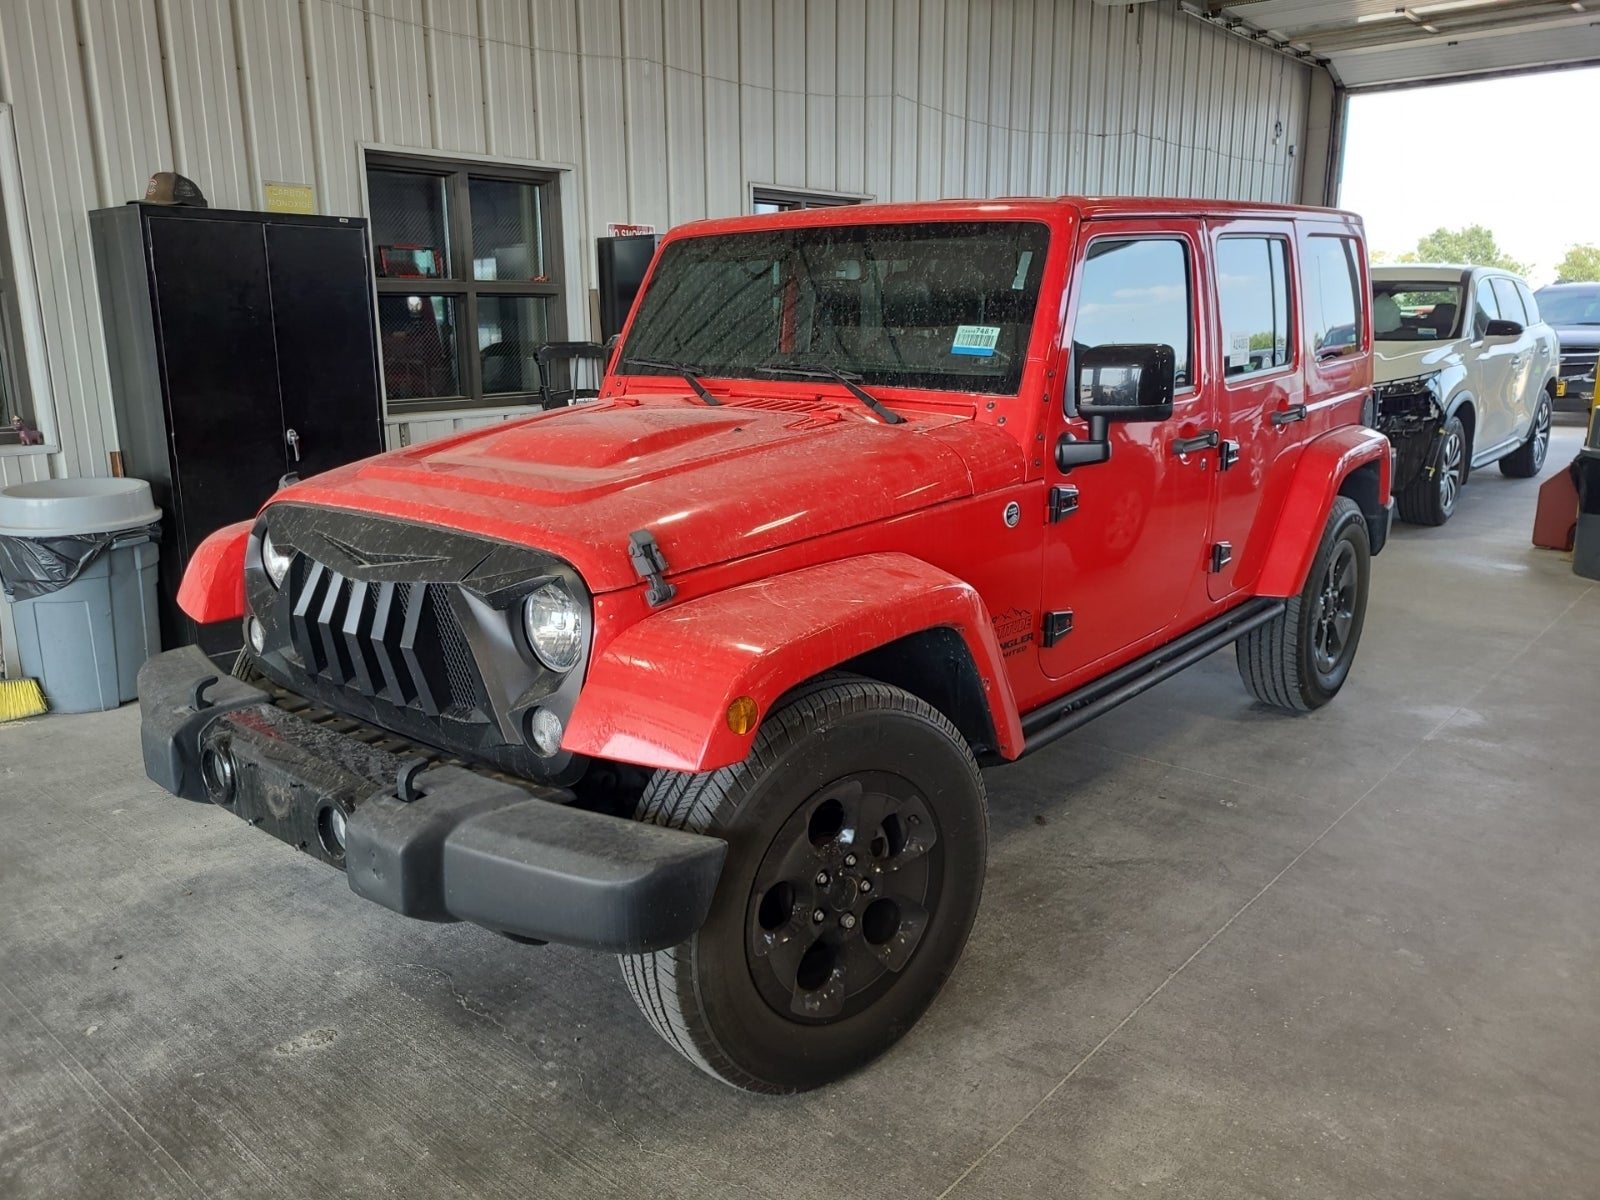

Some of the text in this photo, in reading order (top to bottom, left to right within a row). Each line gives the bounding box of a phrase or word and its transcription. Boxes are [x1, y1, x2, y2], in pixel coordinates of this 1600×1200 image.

[271, 188, 308, 199] CARBON
[268, 199, 313, 209] MONOXIDE
[609, 229, 620, 238] NO
[995, 615, 1032, 640] TITUDE
